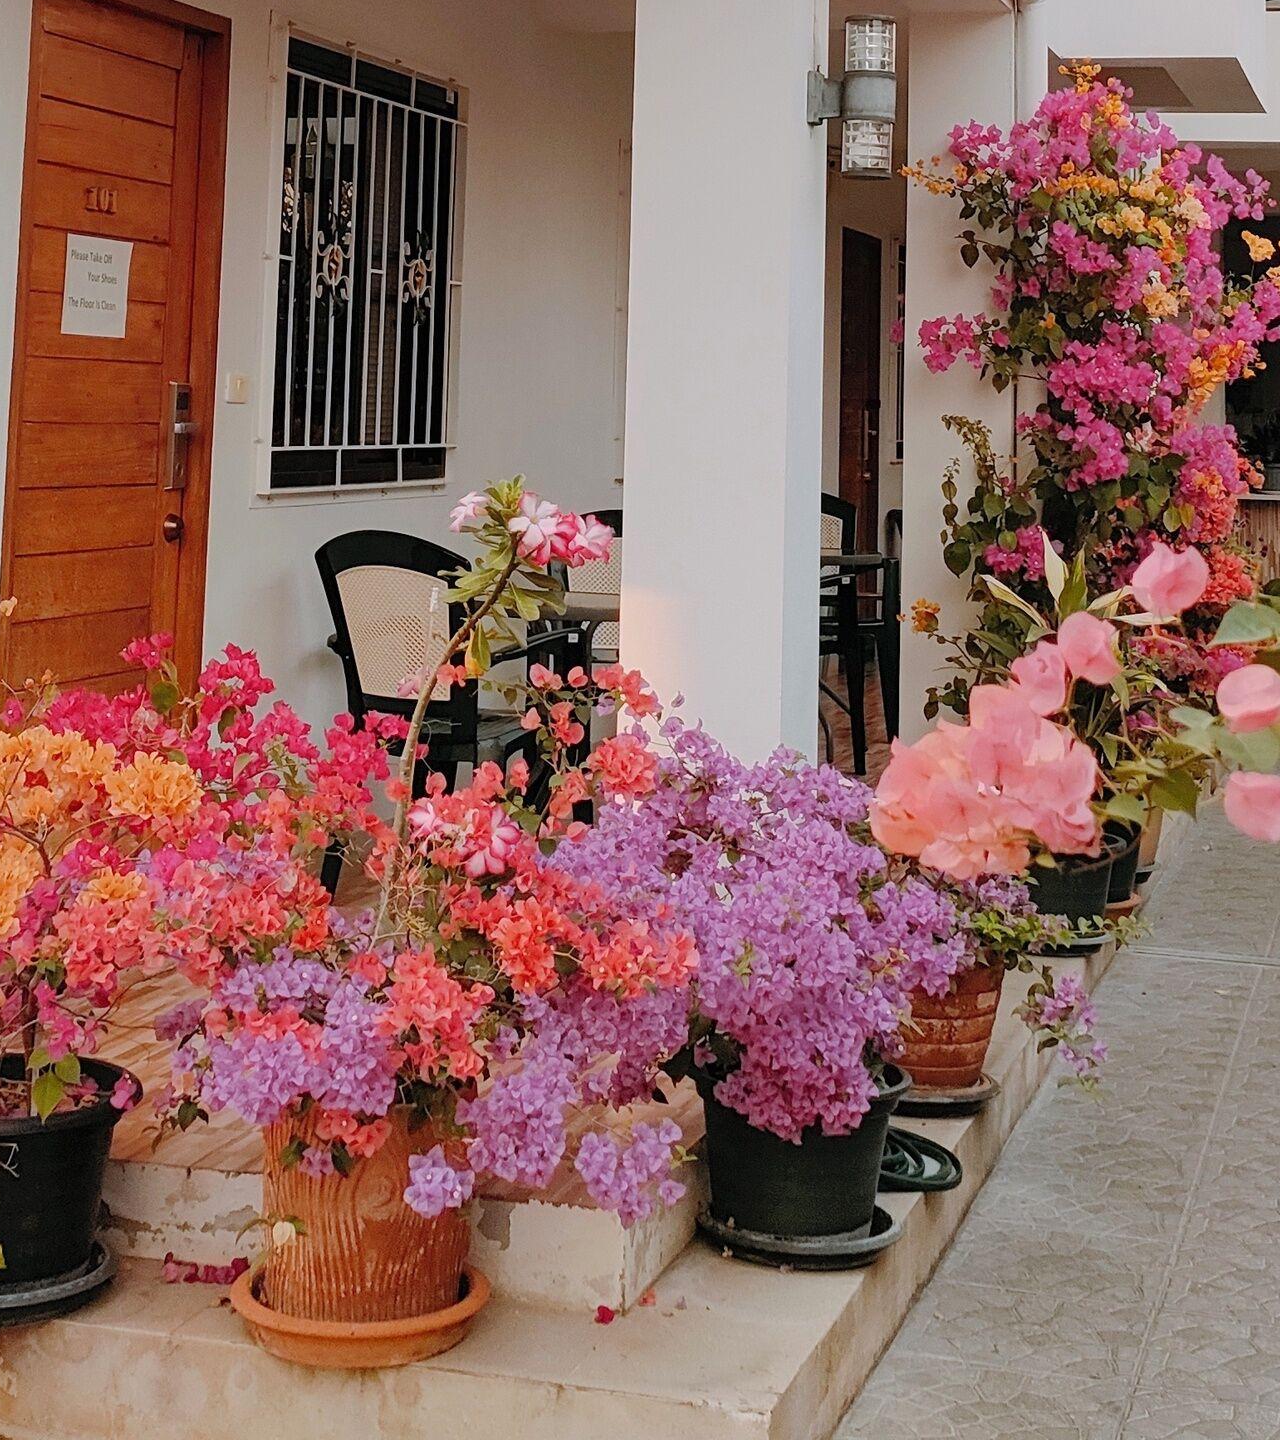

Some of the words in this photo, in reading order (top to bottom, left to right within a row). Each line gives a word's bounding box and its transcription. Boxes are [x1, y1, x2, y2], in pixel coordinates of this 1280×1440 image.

[86, 186, 118, 214] 101
[71, 249, 88, 261] Please
[90, 252, 102, 263] Take
[88, 271, 100, 282] Your
[101, 273, 117, 284] Shoes
[68, 296, 78, 307] The
[80, 298, 94, 309] Floor
